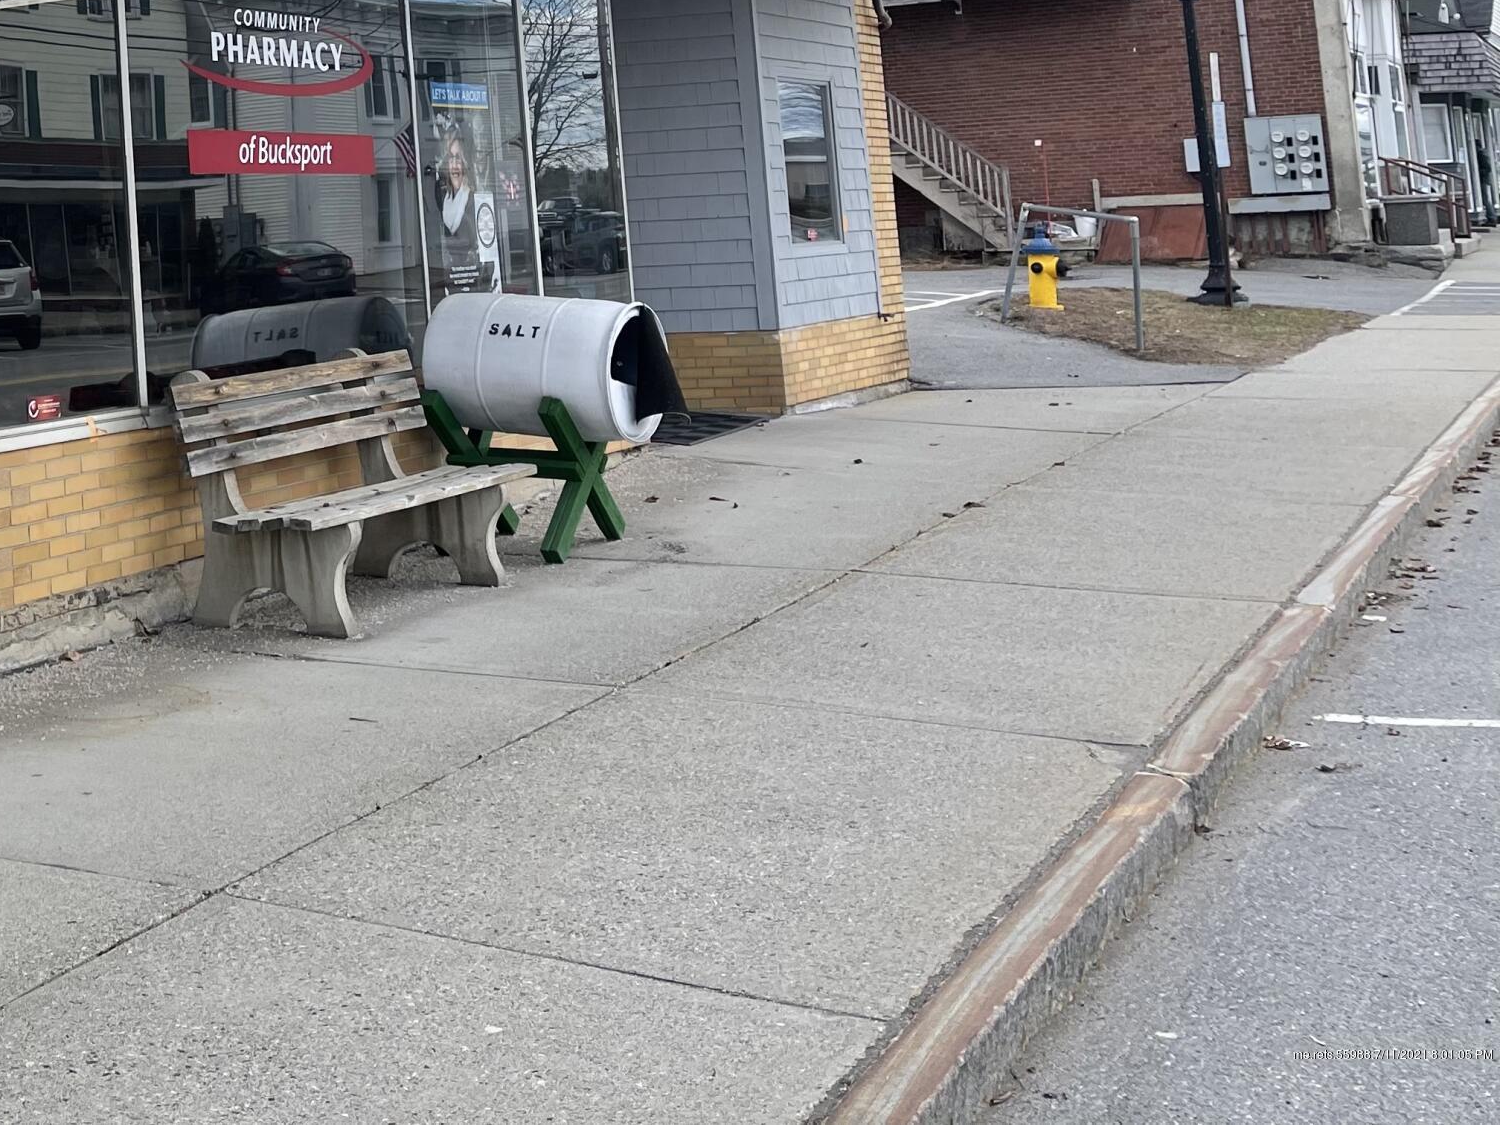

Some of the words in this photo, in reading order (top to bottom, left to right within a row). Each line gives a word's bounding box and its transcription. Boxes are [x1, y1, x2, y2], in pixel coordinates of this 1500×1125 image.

[233, 8, 320, 33] COMMUNITY
[210, 31, 343, 72] PHARMACY
[239, 135, 257, 164] of
[258, 136, 332, 171] Bucksport
[488, 323, 541, 339] SALT
